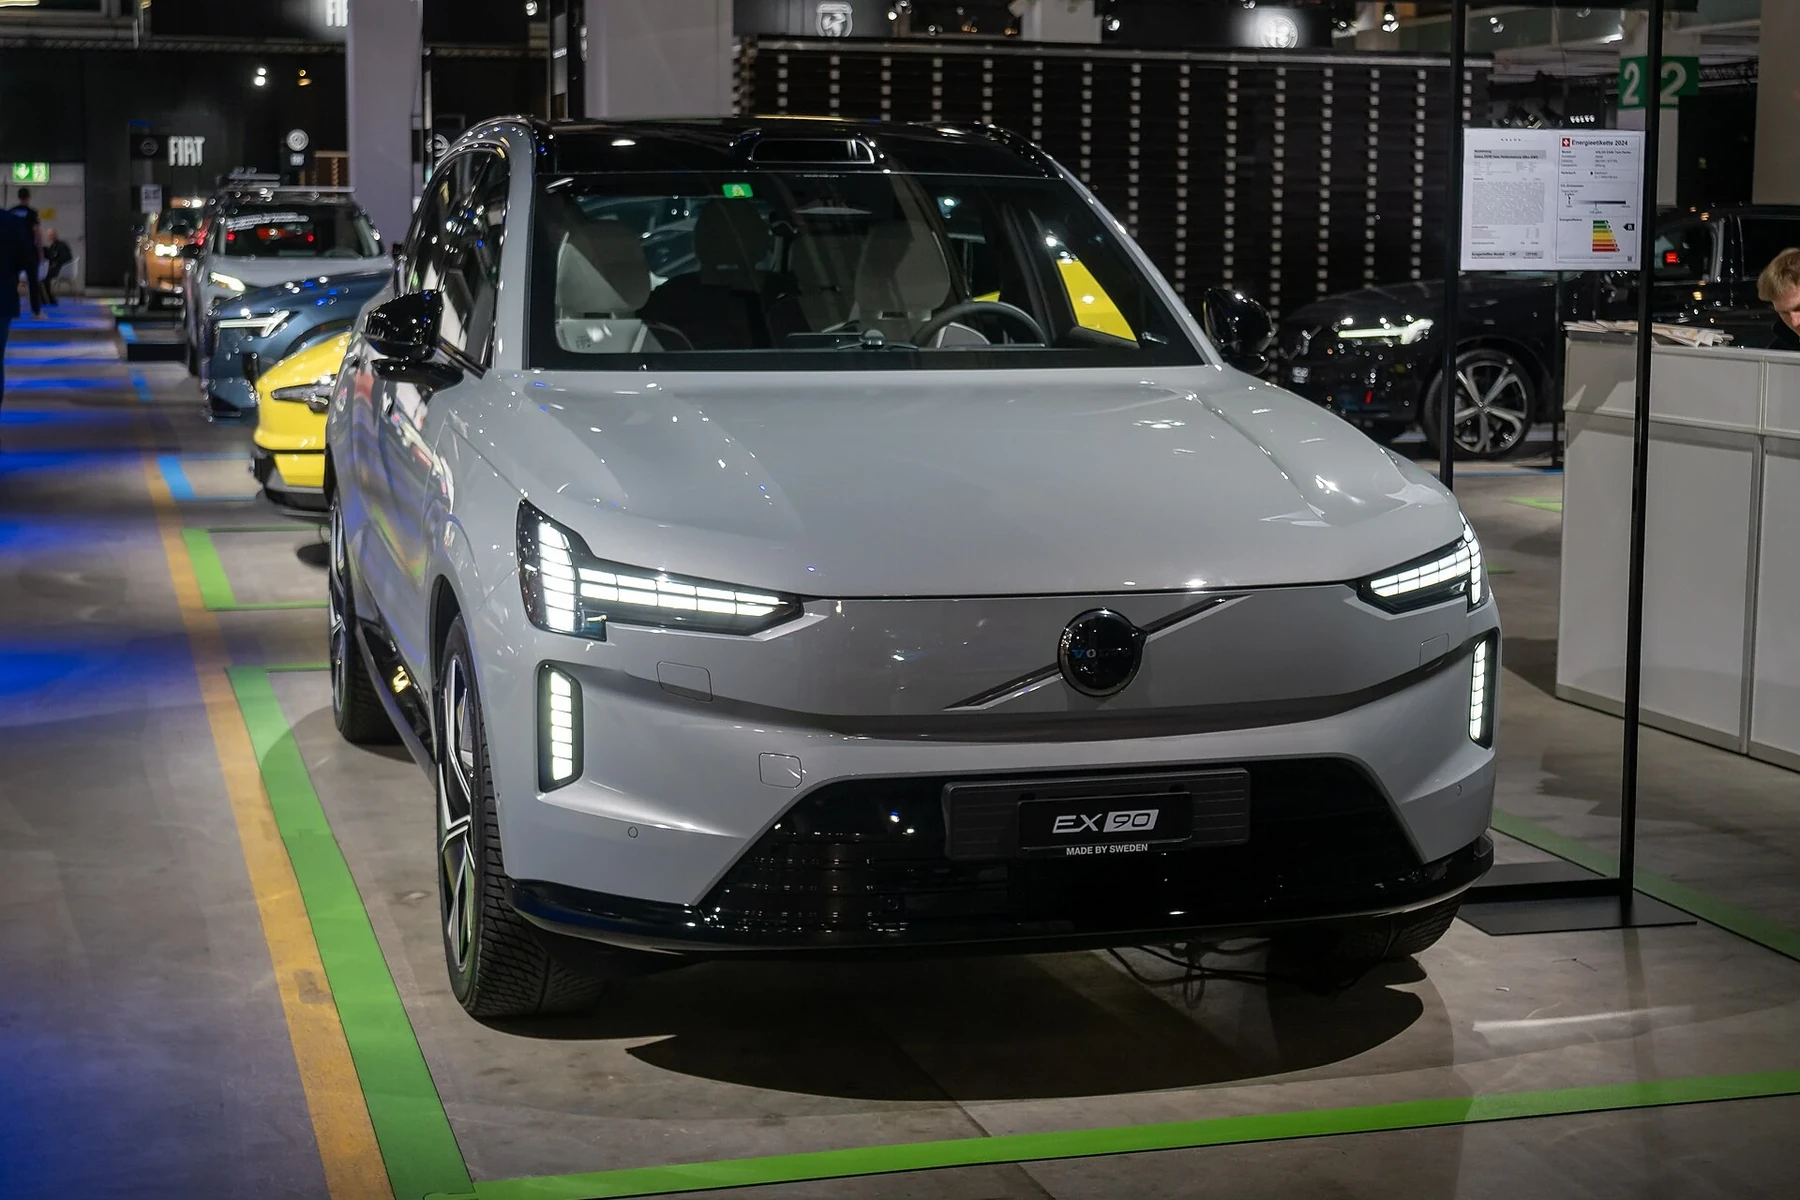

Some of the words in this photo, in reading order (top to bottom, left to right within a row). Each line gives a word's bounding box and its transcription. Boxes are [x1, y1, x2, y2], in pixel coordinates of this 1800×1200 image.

[326, 0, 348, 27] FI
[1622, 62, 1640, 105] 2
[1660, 62, 1687, 105] 2
[168, 135, 206, 167] FIAT
[1066, 846, 1093, 856] MADE
[1095, 845, 1108, 854] BY
[1109, 843, 1148, 853] SWEDEN
